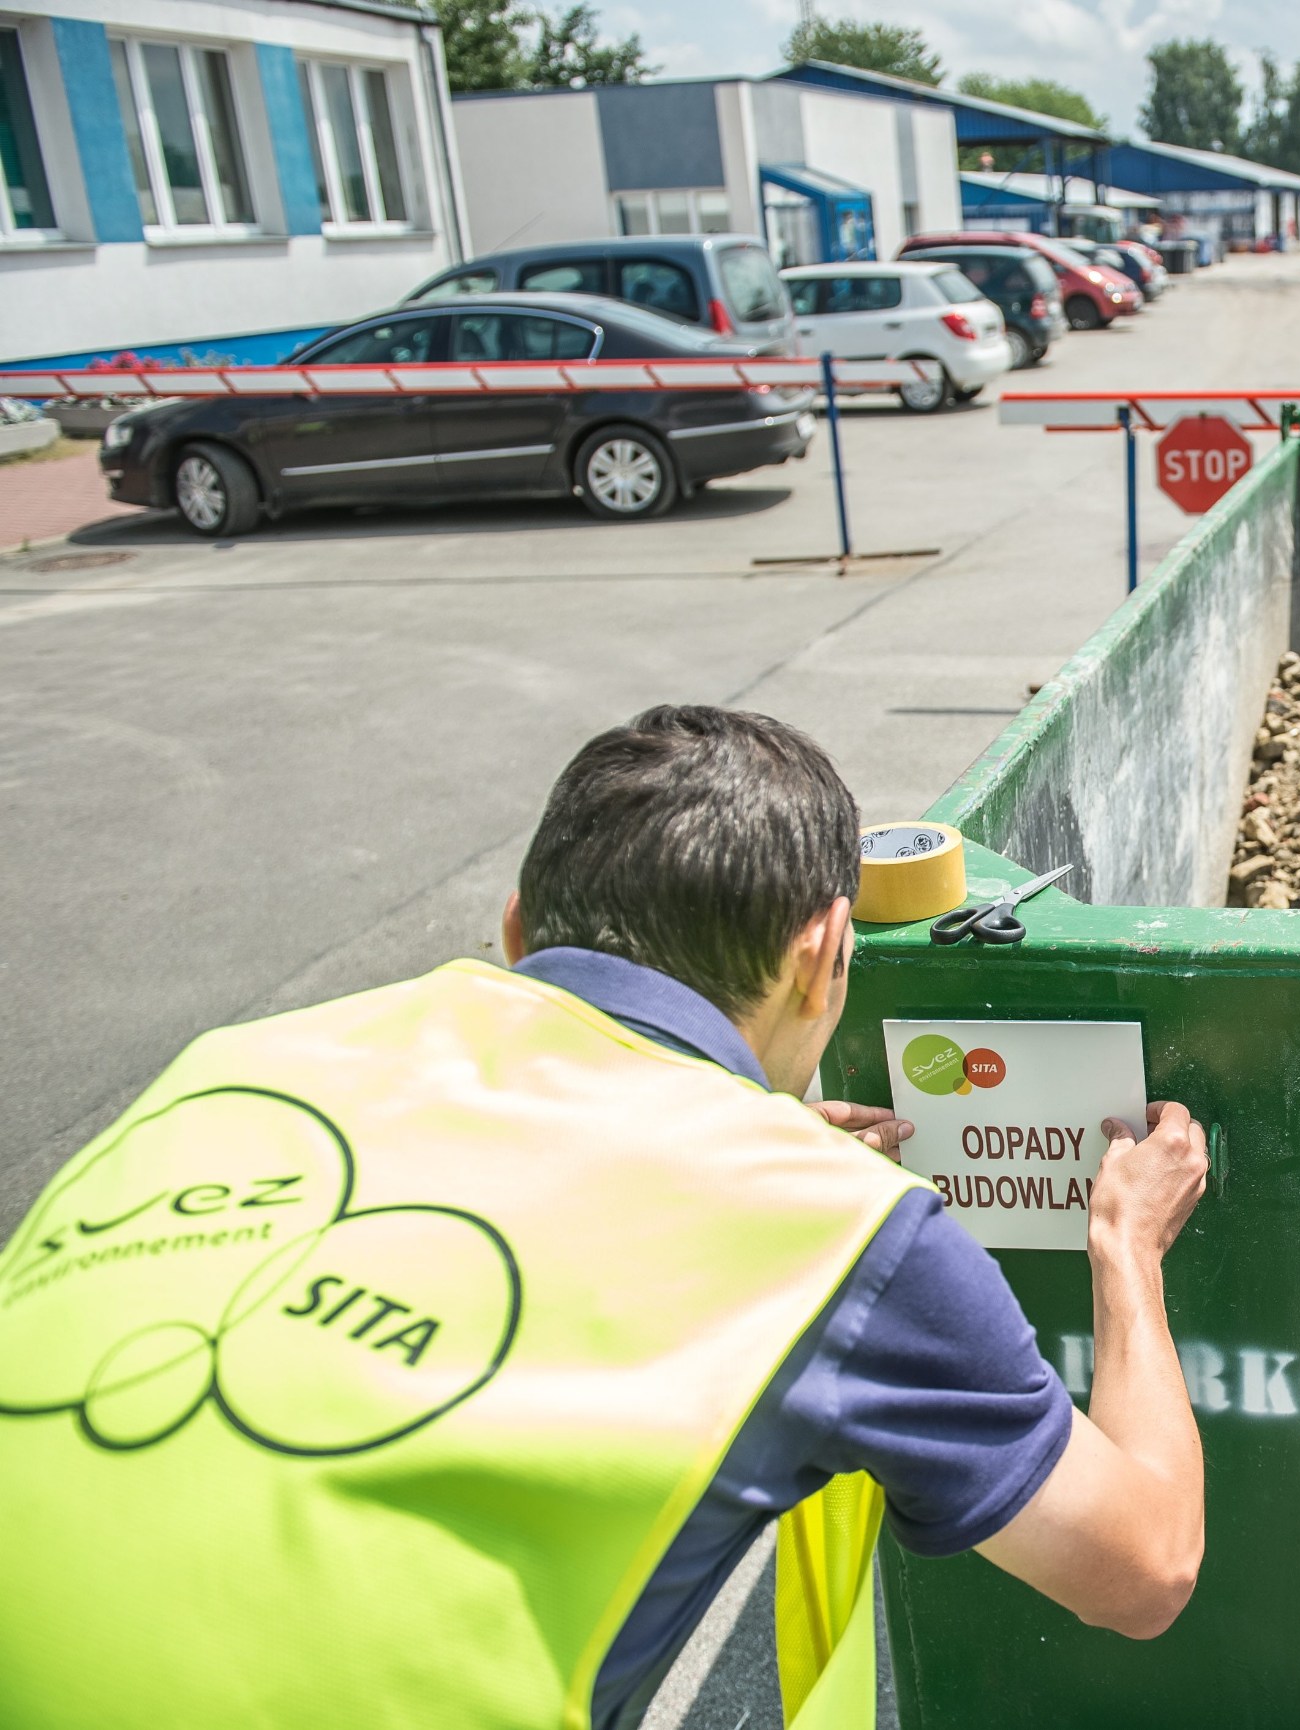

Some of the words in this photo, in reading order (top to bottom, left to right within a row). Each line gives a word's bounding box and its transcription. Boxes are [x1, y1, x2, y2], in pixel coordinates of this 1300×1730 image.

[1164, 449, 1247, 482] STOP
[918, 1057, 960, 1083] environnement
[971, 1063, 998, 1073] SITA
[961, 1125, 1085, 1161] ODPADY
[283, 1276, 439, 1366] SITA
